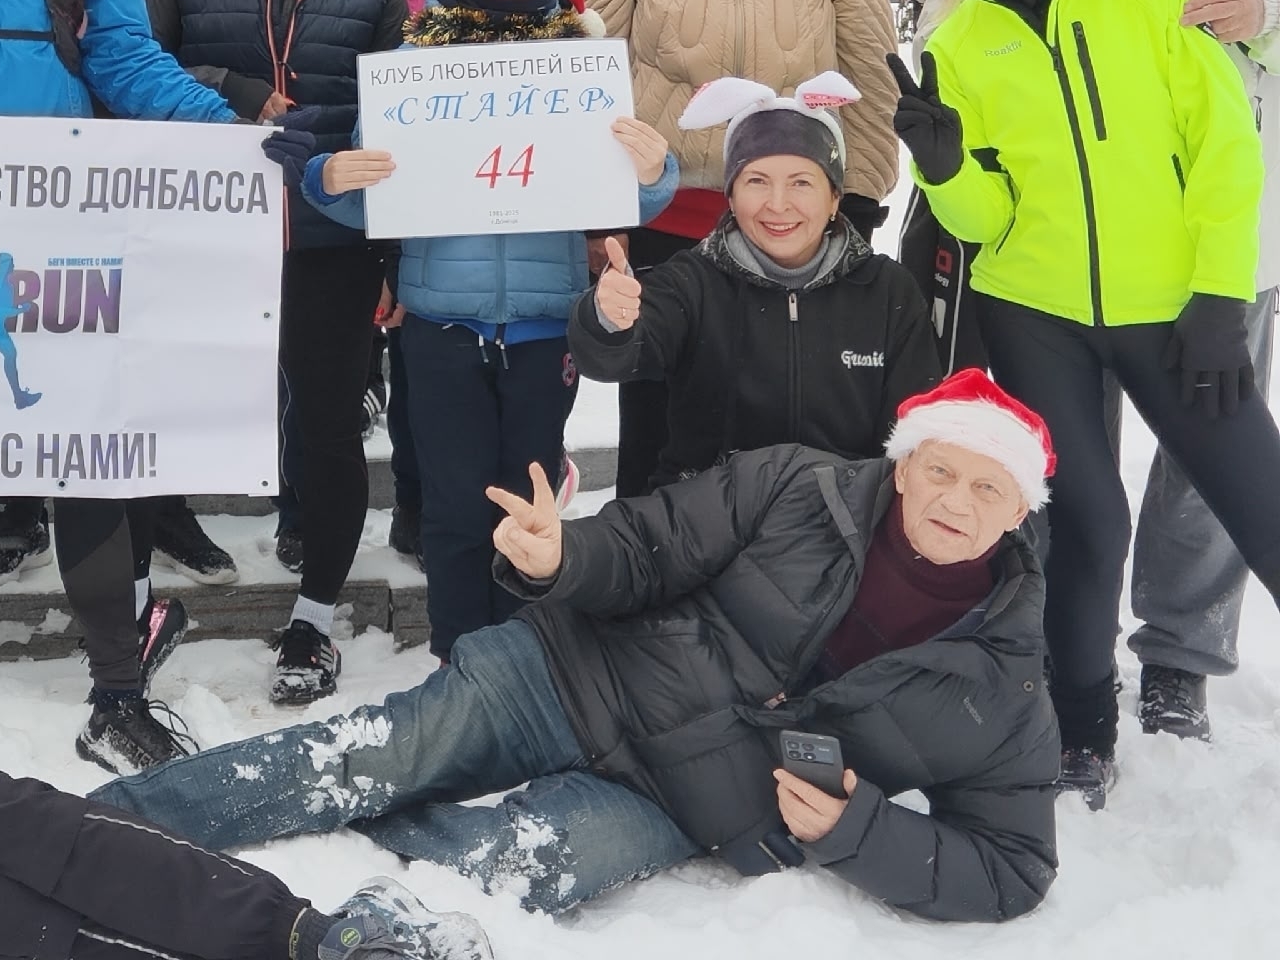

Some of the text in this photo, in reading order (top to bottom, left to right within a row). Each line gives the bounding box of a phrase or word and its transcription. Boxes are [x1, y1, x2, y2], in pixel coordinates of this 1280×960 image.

[371, 53, 621, 86] КЛУБ ЛЮБИТЕЛЕЙ БЕГА
[383, 84, 616, 126] «СТАЙЕР»
[474, 143, 535, 189] 44
[78, 166, 270, 215] ДОНБАССА
[47, 257, 65, 267] БЕГИ
[65, 257, 94, 267] ВМЕСТЕ
[95, 257, 100, 267] С
[4, 268, 122, 334] RUN
[0, 432, 24, 479] С
[36, 432, 158, 479] НАМИ!
